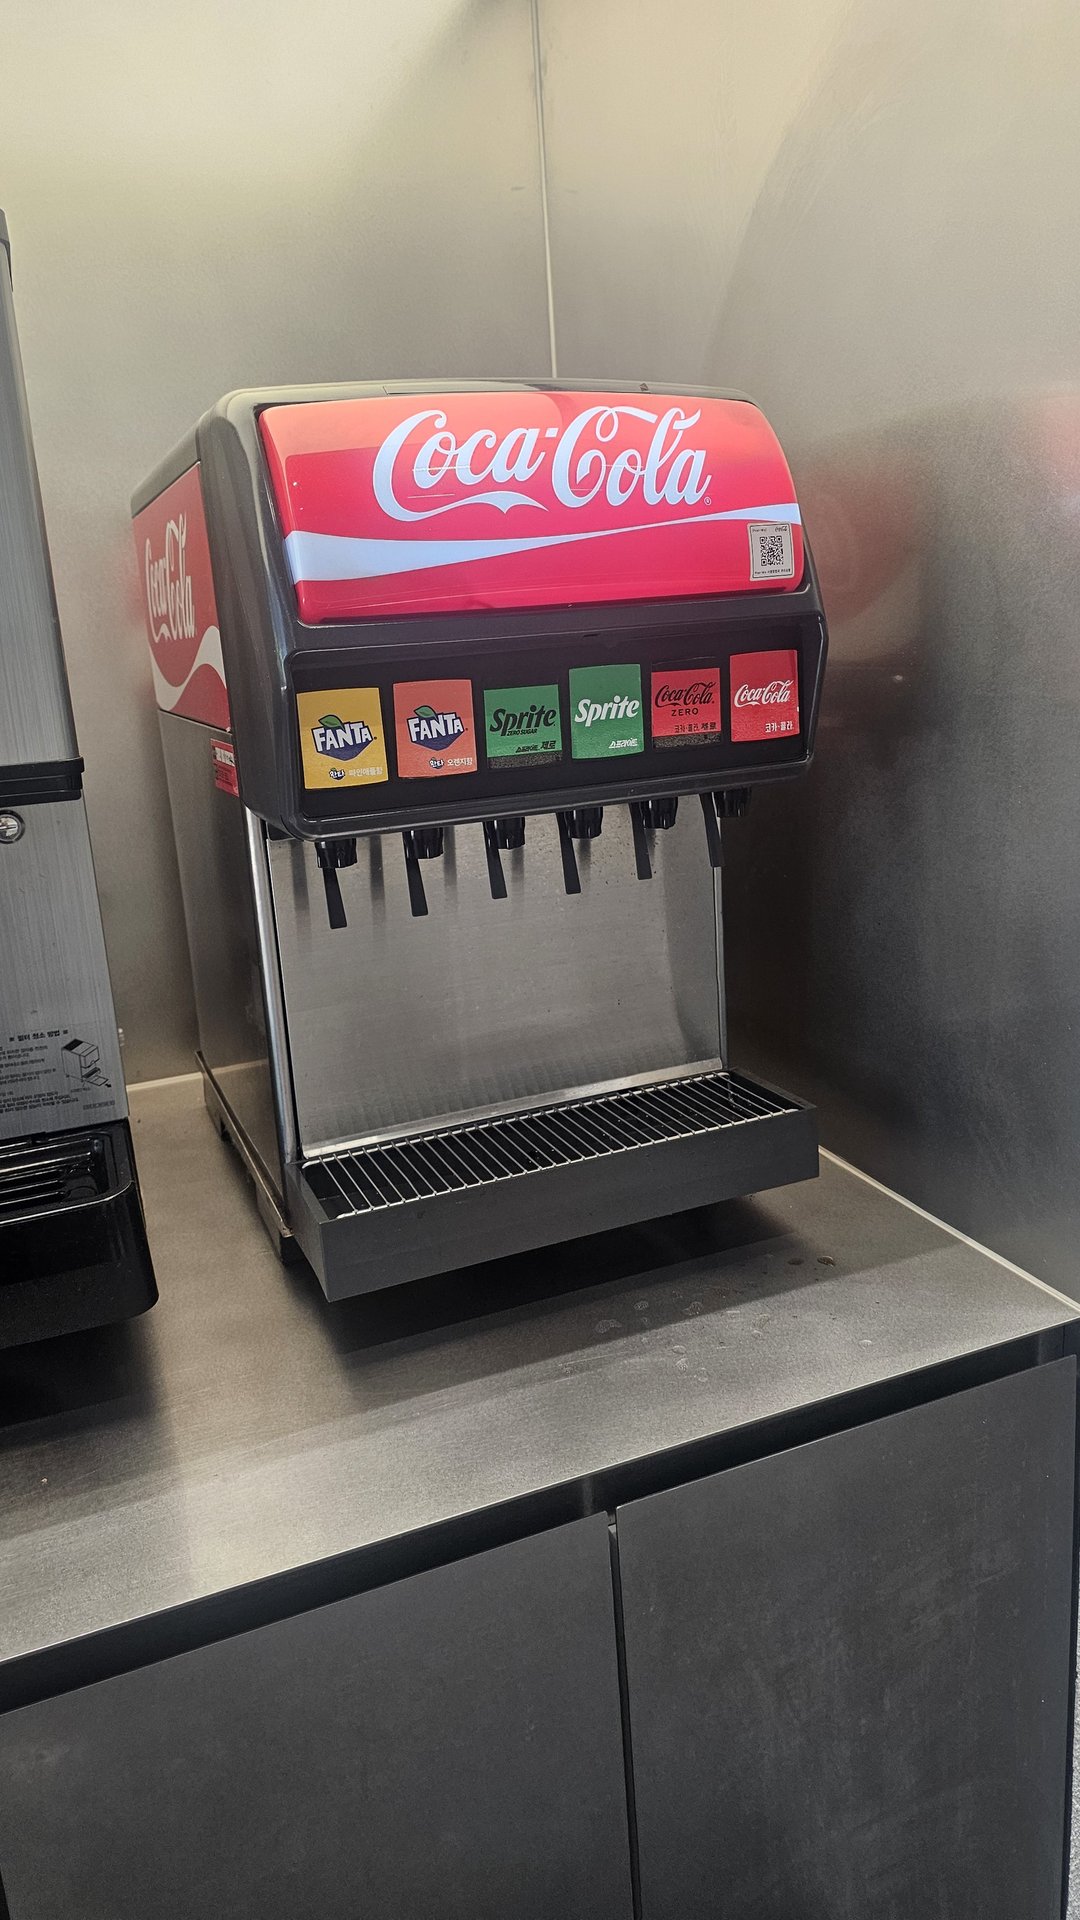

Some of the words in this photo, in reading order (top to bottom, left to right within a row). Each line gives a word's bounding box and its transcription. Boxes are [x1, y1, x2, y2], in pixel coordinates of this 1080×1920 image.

[372, 405, 712, 522] Coca-Cola
[654, 682, 716, 708] Coca-Cola
[734, 679, 794, 708] Coca-Cola
[489, 704, 557, 737] Sprite
[575, 695, 640, 727] Sprite
[671, 708, 699, 717] ZERO
[312, 723, 372, 752] FANTA
[407, 712, 464, 742] FANTA
[507, 729, 520, 737] ZERO
[521, 728, 538, 736] SUGAR
[540, 740, 557, 750] 제로
[608, 737, 638, 749] 스프라이트
